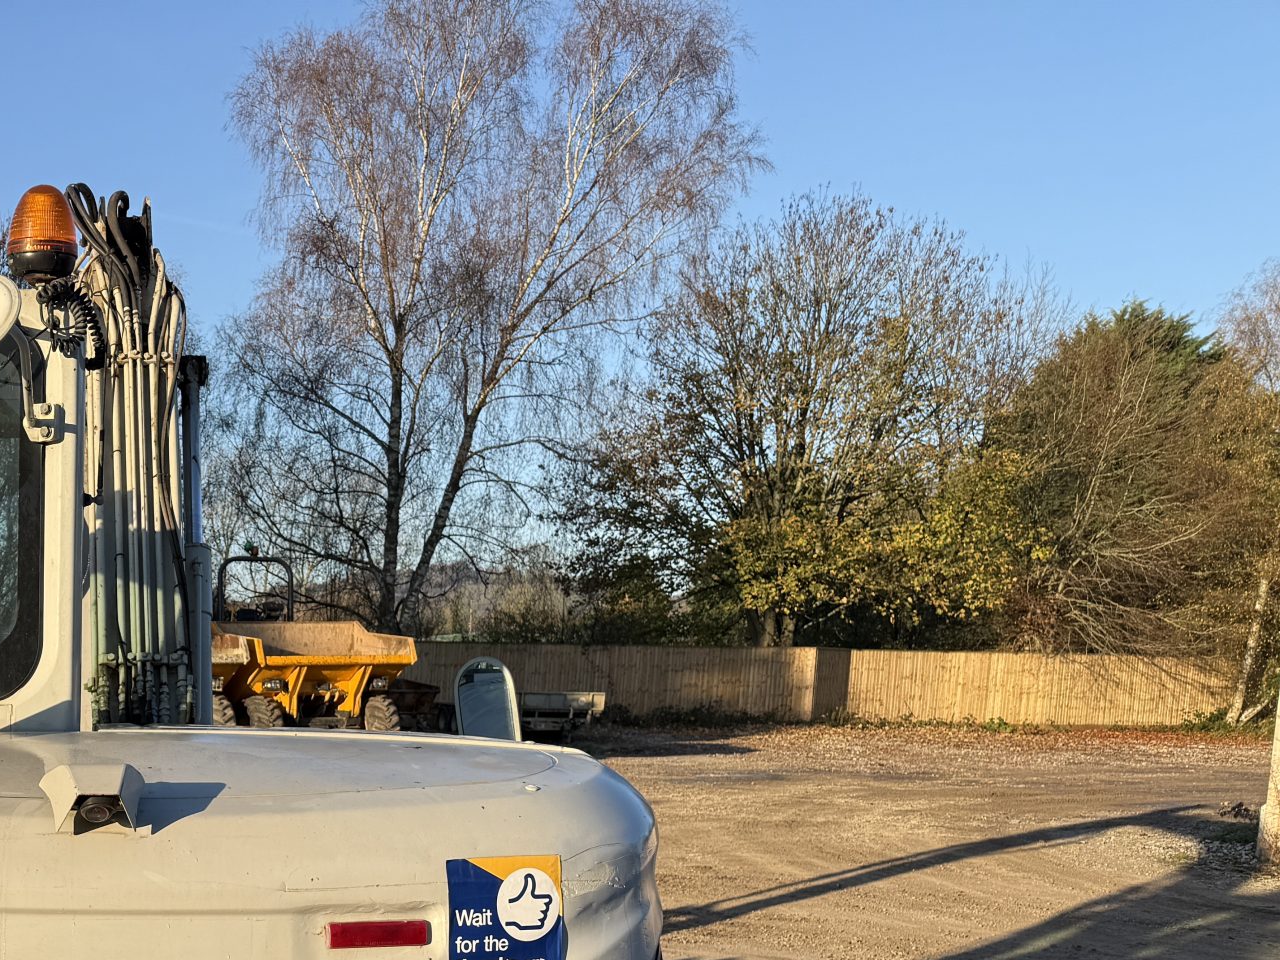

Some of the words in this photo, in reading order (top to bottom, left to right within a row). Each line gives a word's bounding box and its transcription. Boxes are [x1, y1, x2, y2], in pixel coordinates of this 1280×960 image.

[456, 909, 492, 927] Wait
[455, 937, 478, 953] for
[484, 935, 508, 951] the
